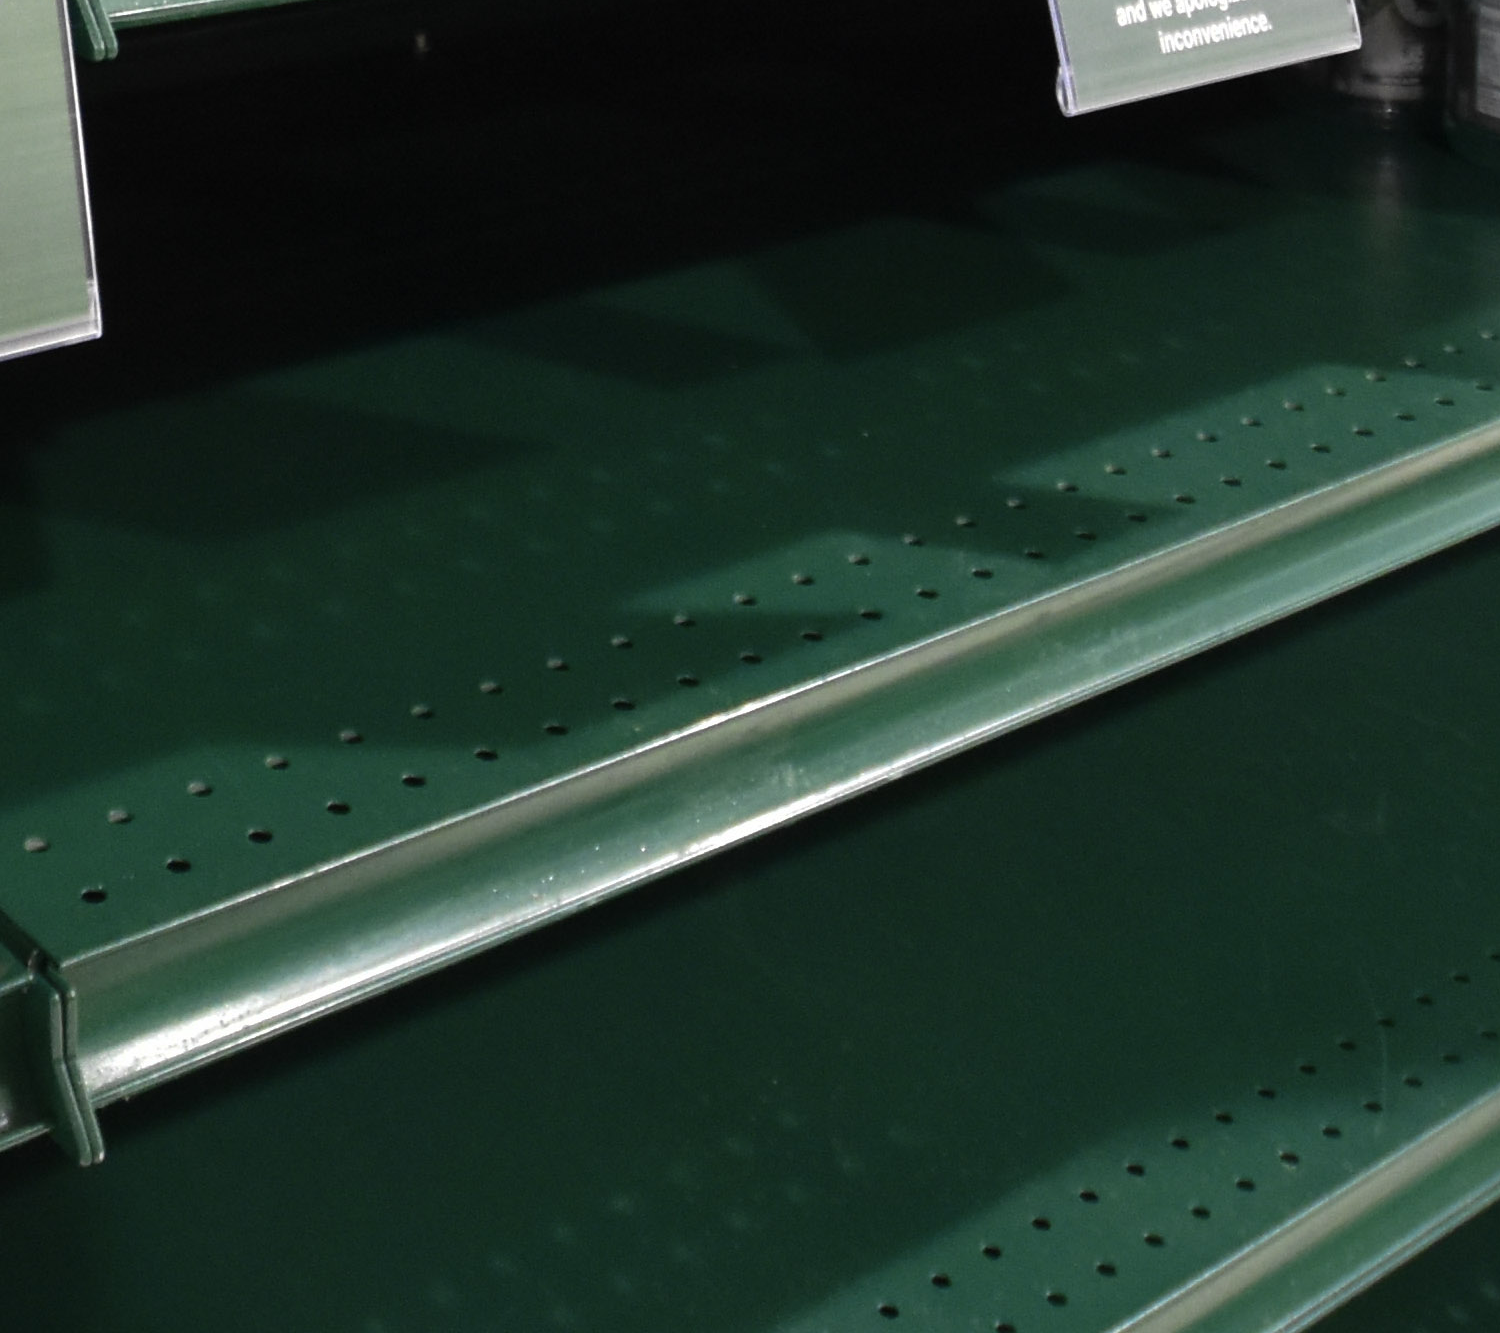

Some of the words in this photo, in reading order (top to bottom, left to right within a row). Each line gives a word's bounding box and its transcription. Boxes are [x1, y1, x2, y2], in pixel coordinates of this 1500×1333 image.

[1116, 0, 1146, 27] and
[1150, 0, 1172, 19] we
[1158, 12, 1272, 54] inconvenience.
